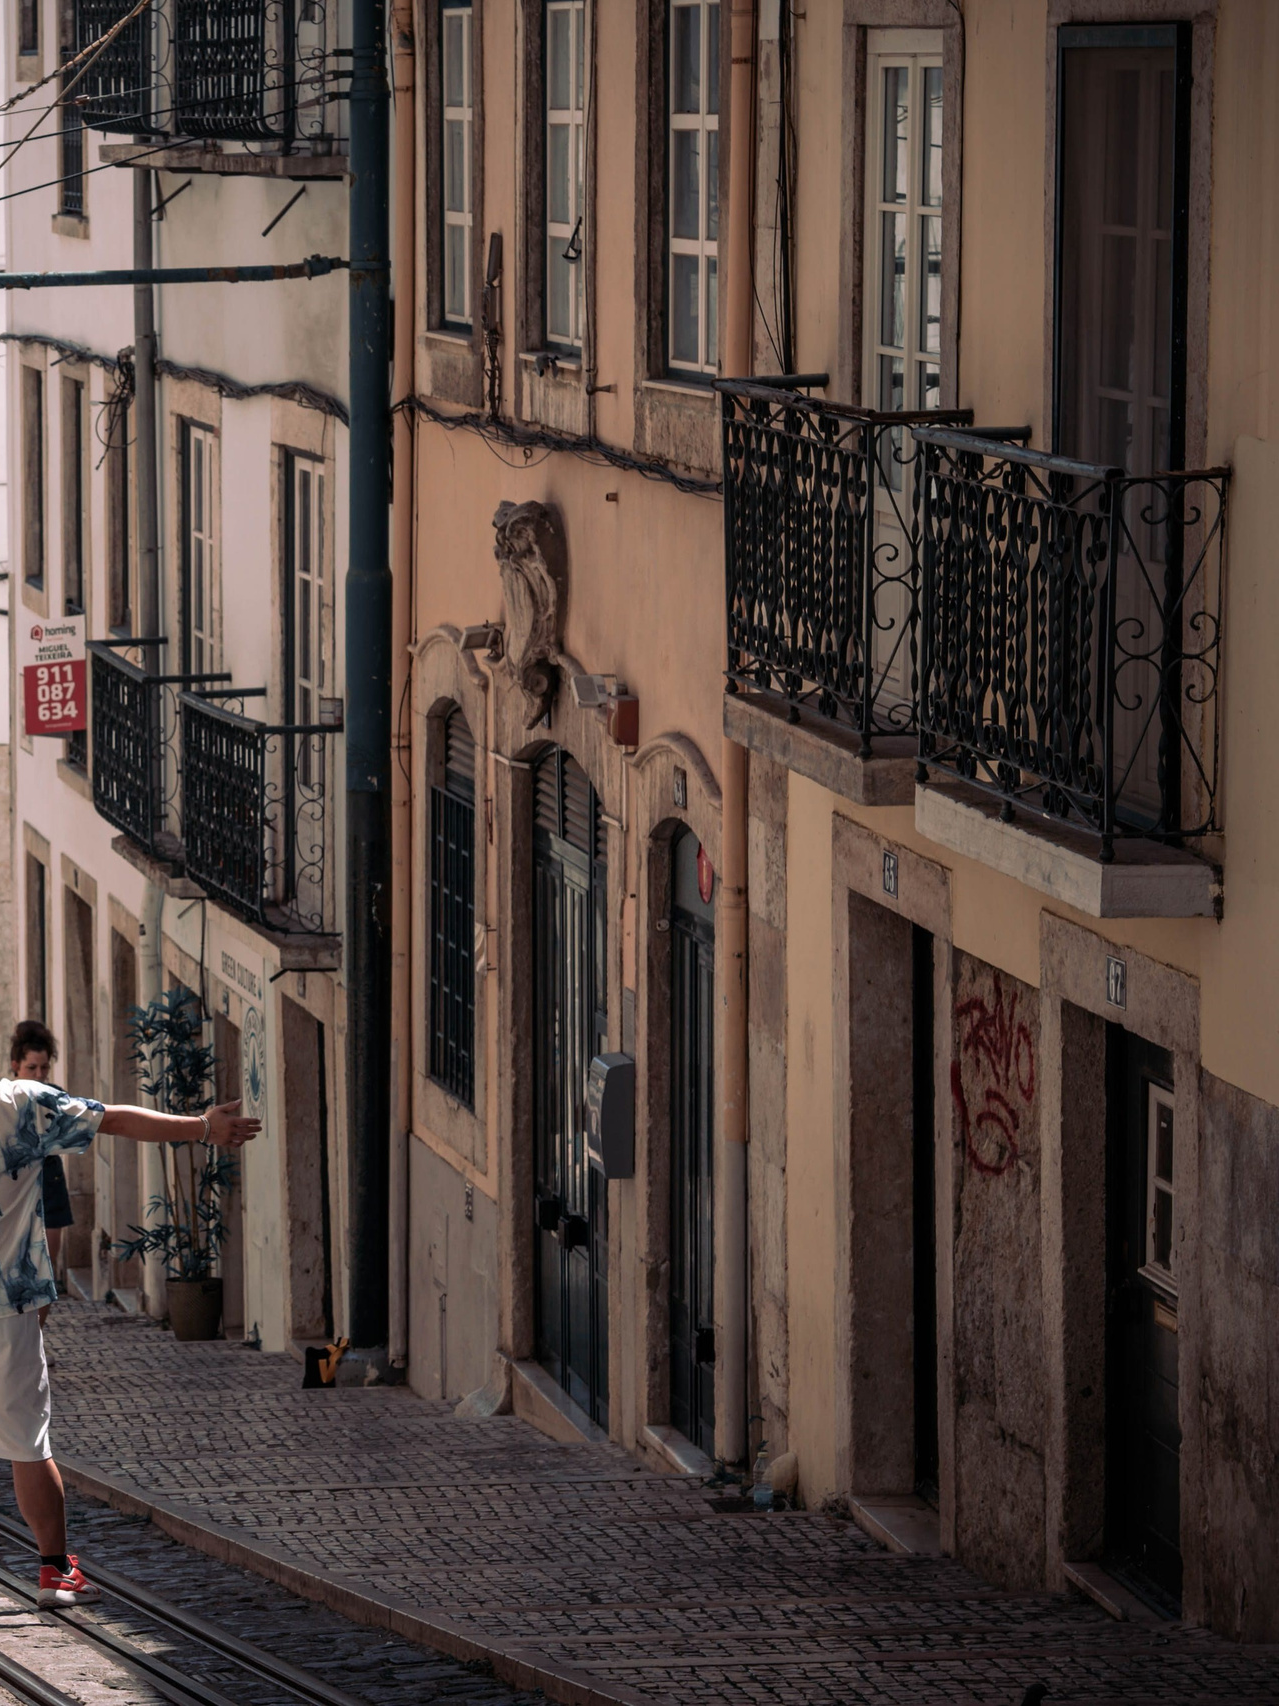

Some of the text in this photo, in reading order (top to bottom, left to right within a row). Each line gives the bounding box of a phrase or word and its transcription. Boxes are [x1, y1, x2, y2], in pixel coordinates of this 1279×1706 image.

[45, 624, 76, 636] homing
[35, 651, 73, 662] TEIXEIRA
[39, 644, 69, 653] MIGUEL
[36, 664, 74, 685] 911
[37, 682, 75, 702] 087
[38, 700, 78, 721] 634
[885, 856, 894, 892] 65
[222, 950, 256, 997] GREEN CULTURE
[1109, 962, 1121, 1002] 67
